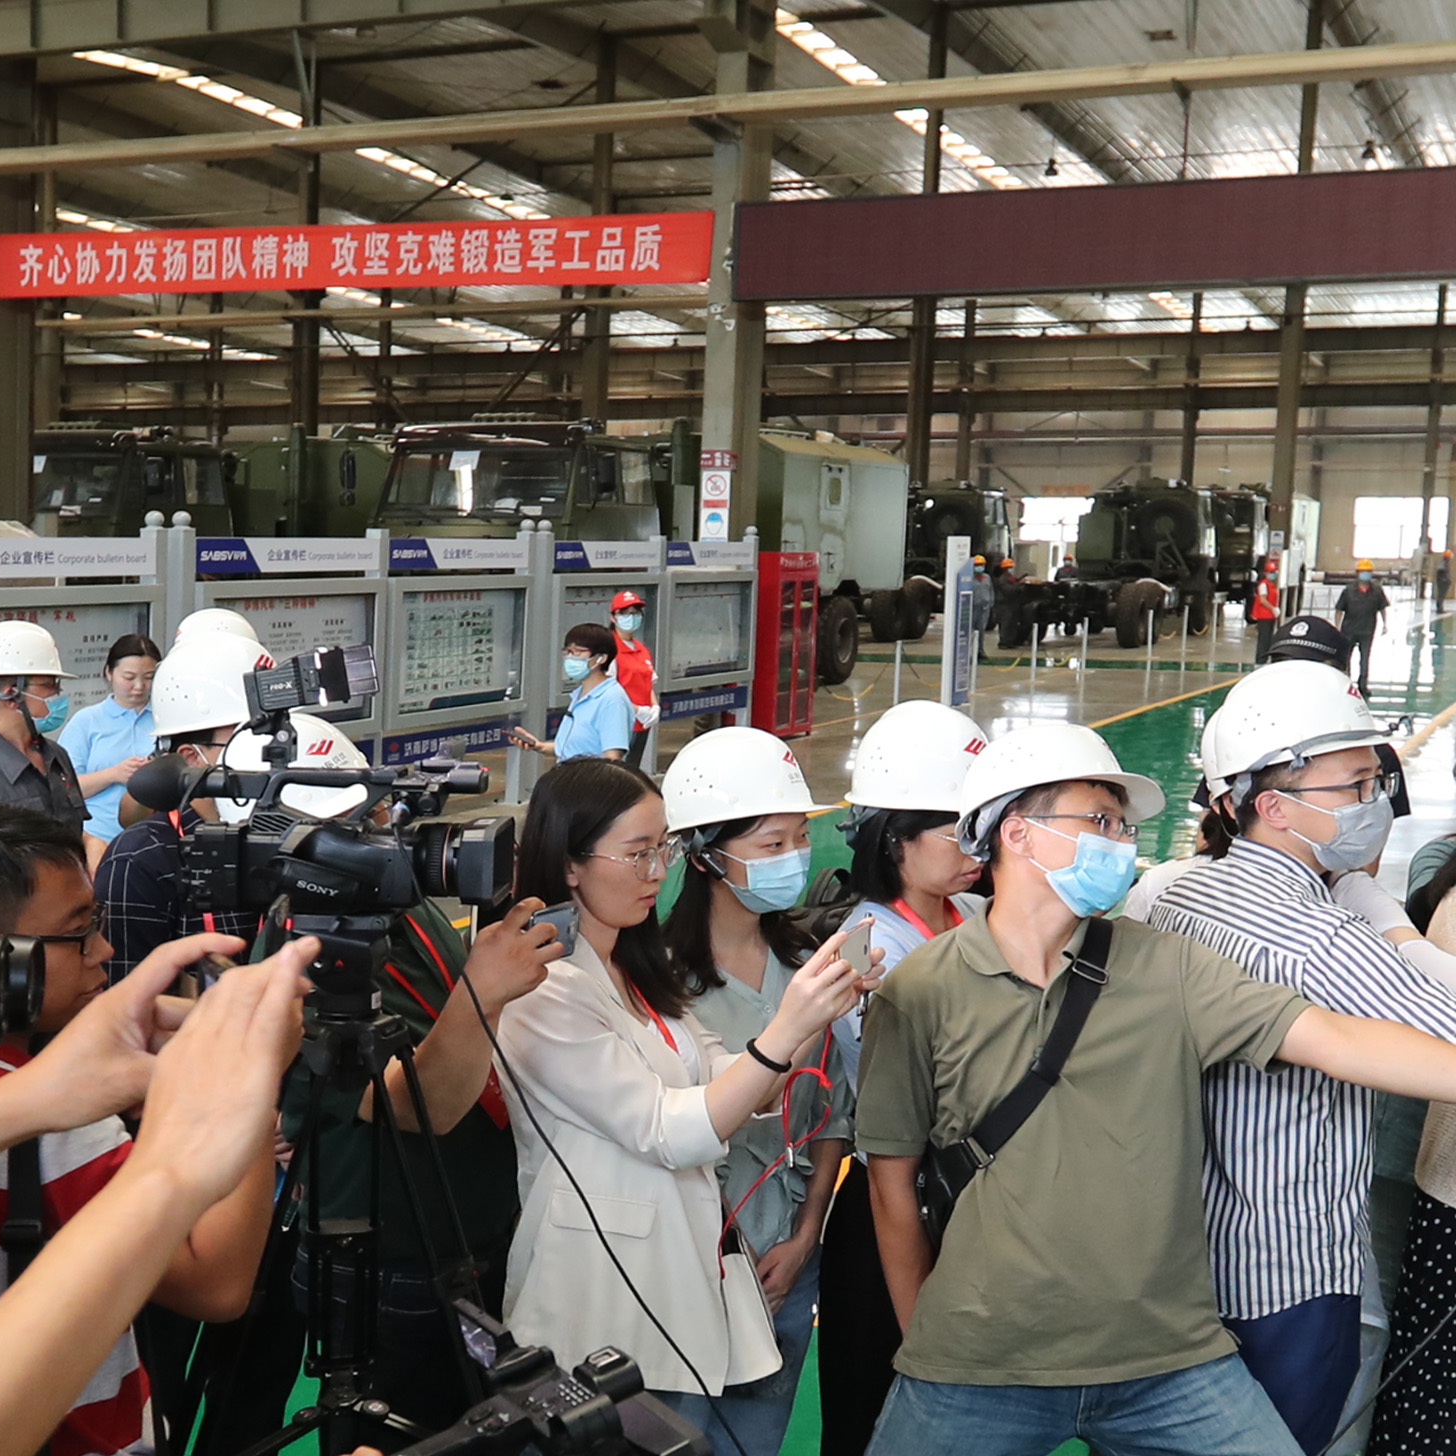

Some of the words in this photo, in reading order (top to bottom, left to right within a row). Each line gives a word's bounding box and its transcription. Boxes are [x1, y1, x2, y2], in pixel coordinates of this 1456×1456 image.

[19, 235, 309, 288] 齐心协力发扬团队精神
[330, 222, 663, 276] 攻坚克难锻造军工品质
[0, 551, 55, 565] 企业宣传栏
[296, 878, 340, 898] SONY
